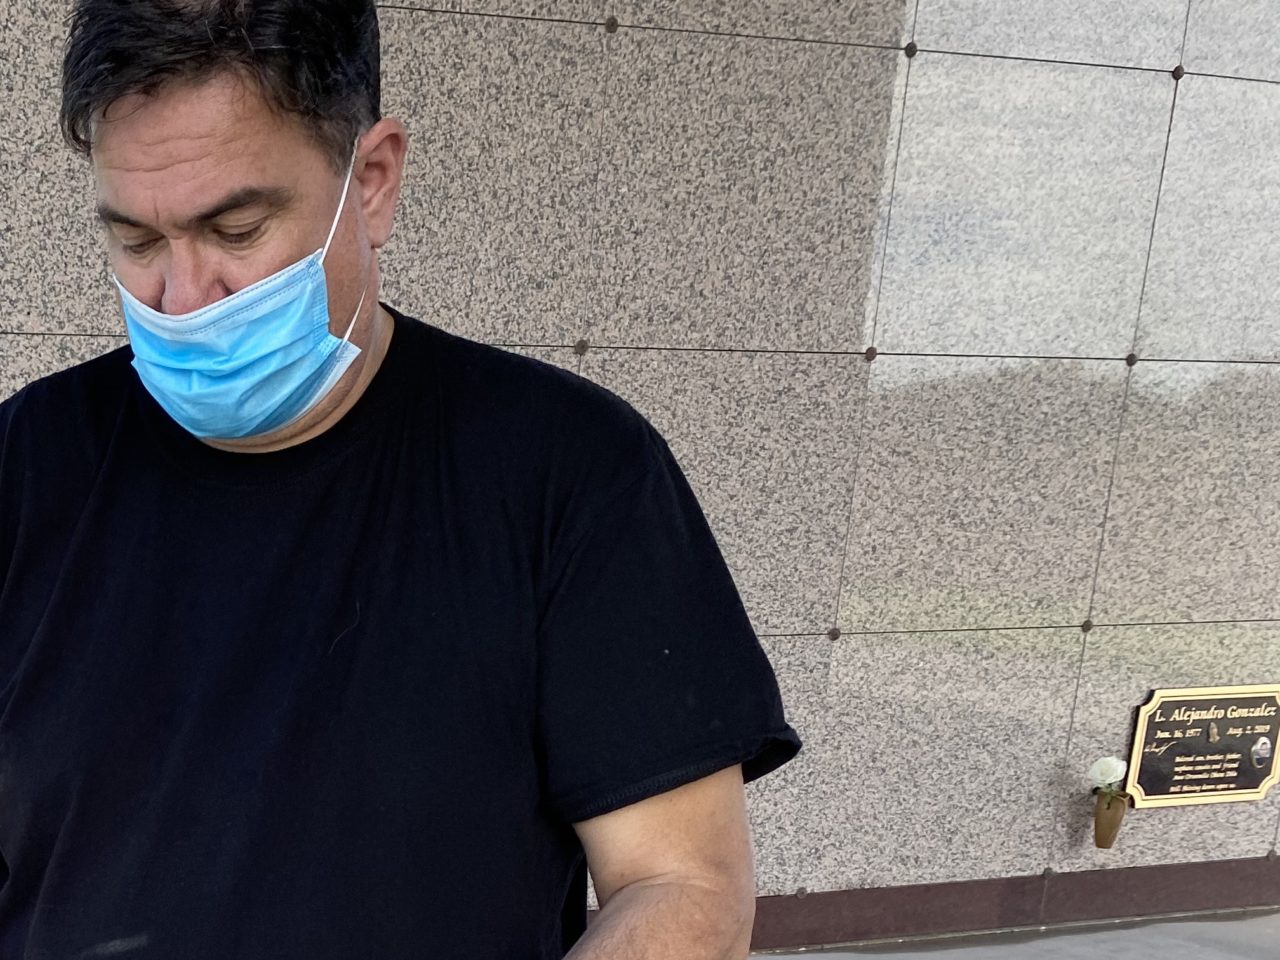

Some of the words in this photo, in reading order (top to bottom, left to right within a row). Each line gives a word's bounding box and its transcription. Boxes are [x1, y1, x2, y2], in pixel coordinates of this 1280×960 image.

[1154, 709, 1166, 722] L.
[1169, 705, 1225, 726] Alejandro
[1227, 702, 1277, 719] Gonzalez
